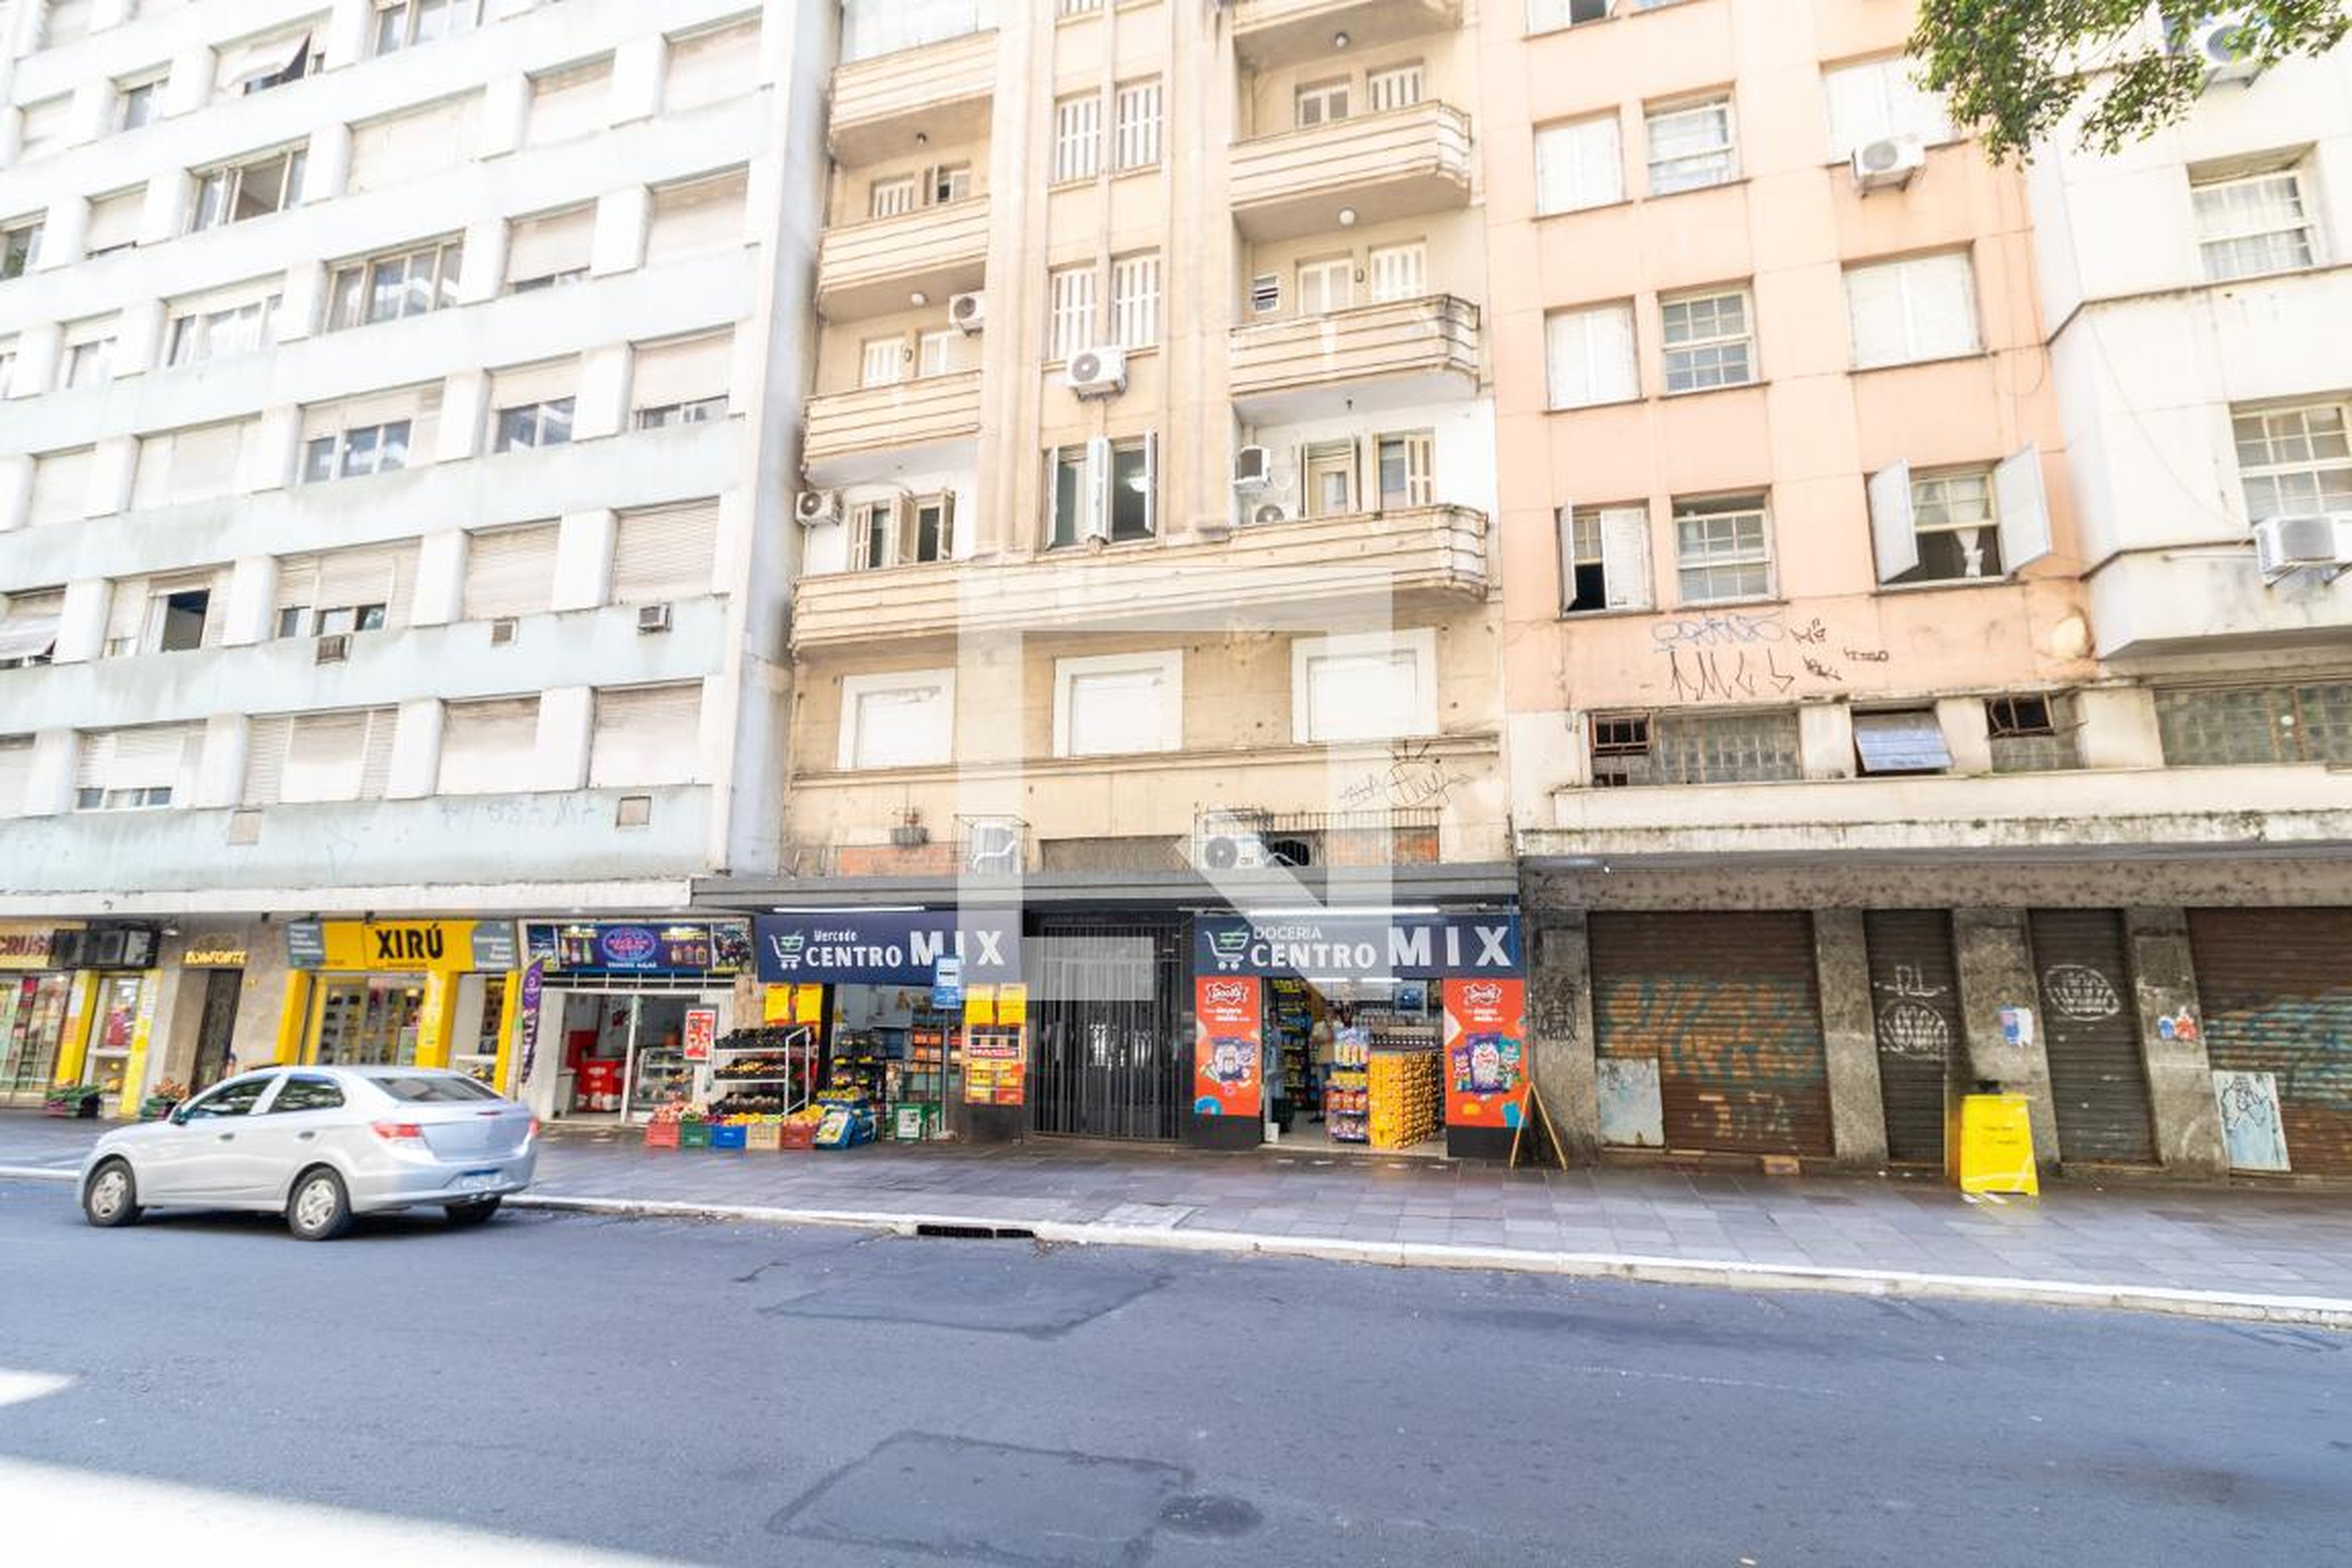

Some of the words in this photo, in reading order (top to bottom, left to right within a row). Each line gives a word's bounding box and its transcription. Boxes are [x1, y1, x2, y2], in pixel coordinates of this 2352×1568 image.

[375, 923, 444, 959] XIRÚ
[805, 945, 902, 968] CENTRO
[910, 930, 1005, 967] MIX
[813, 929, 857, 942] Mercado
[1250, 943, 1376, 968] CENTRO
[1388, 926, 1513, 967] MIX
[1253, 925, 1322, 940] DOCERIA
